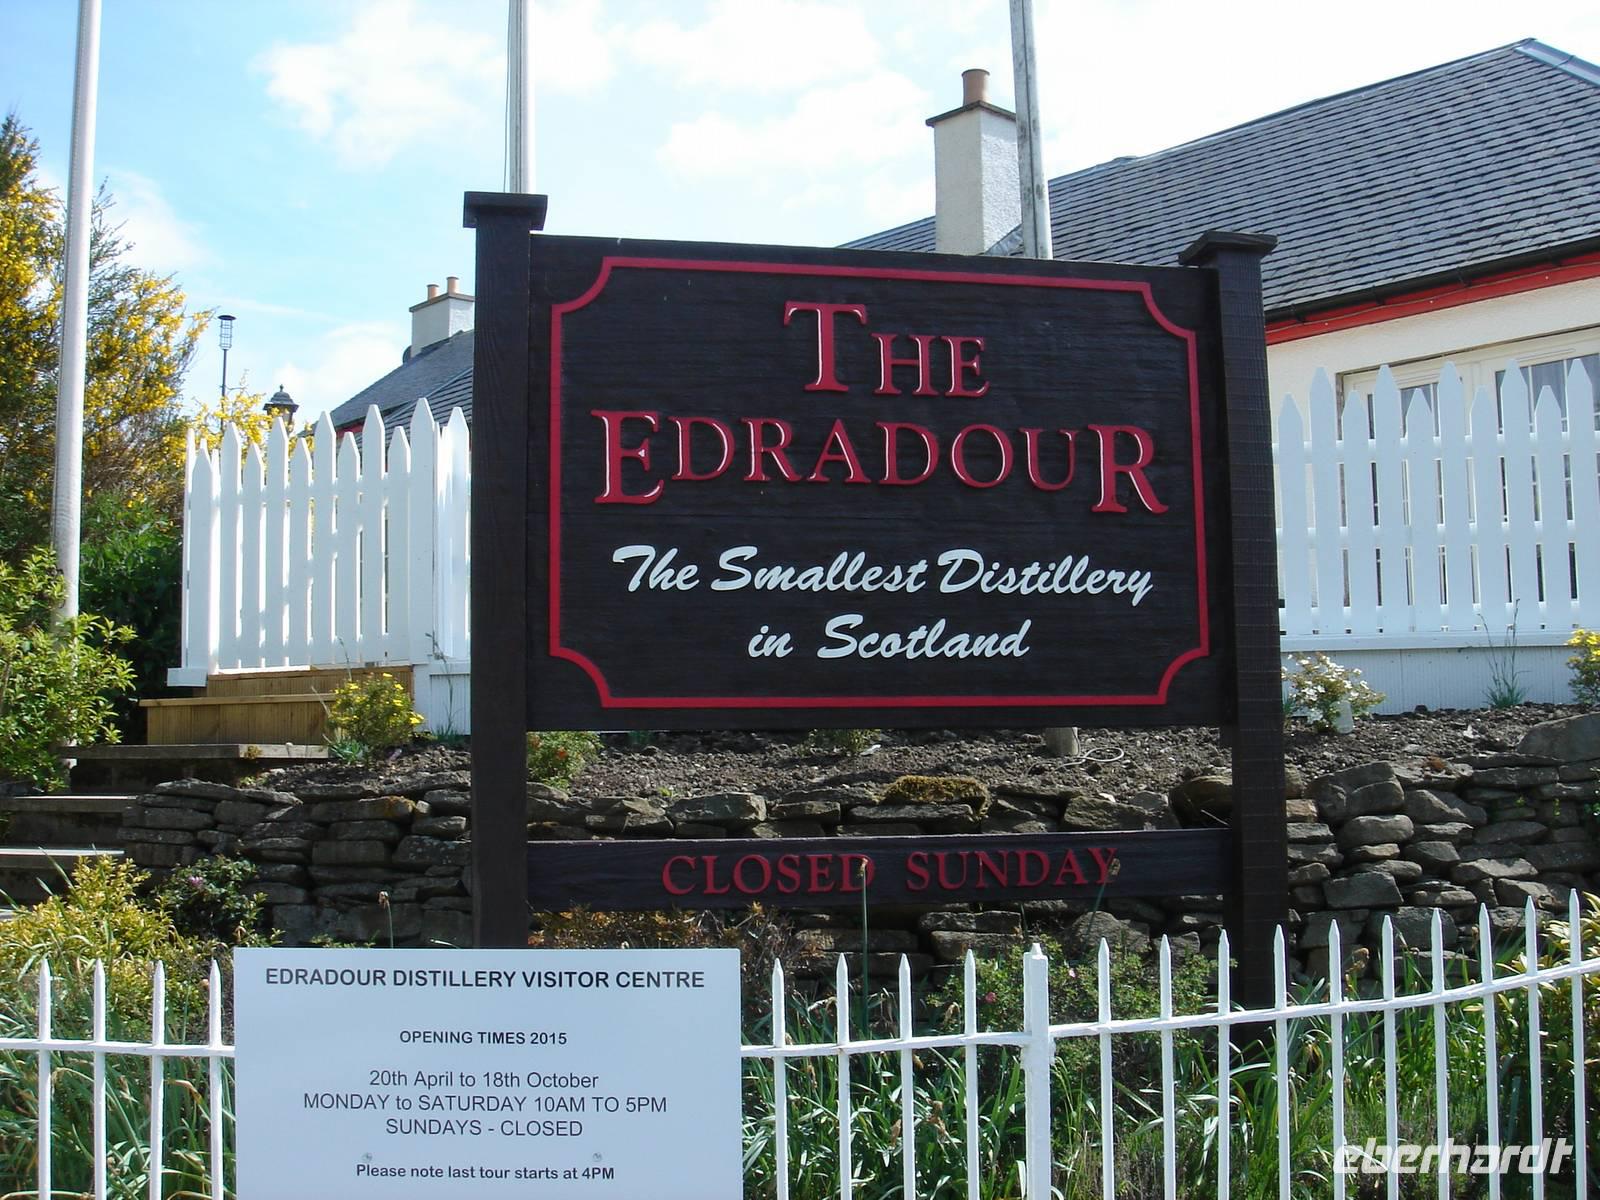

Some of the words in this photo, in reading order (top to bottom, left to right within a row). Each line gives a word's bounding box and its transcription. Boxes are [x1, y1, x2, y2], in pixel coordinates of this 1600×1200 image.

[783, 301, 990, 397] THE
[591, 410, 1169, 514] EDRADOUR
[612, 545, 700, 592] The
[711, 546, 928, 594] Smallest
[936, 548, 1153, 606] Distillery
[748, 623, 794, 658] in
[817, 614, 1032, 659] Scotland
[662, 855, 875, 895] CLOSED
[905, 848, 1119, 890] SUNDAY
[265, 968, 387, 987] EDRADOUR
[393, 969, 516, 988] DISTILLERY
[522, 970, 609, 989] VISITOR
[615, 970, 705, 989] CENTRE
[399, 1030, 473, 1044] OPENING
[477, 1031, 525, 1045] TIMES
[530, 1032, 567, 1045] 2015
[369, 1070, 407, 1087] 20th
[413, 1070, 453, 1091] April
[459, 1072, 476, 1087] to
[482, 1072, 520, 1088] 18th
[526, 1072, 599, 1089] October
[304, 1093, 390, 1110] MONDAY
[396, 1095, 412, 1111] to
[418, 1095, 527, 1112] SATURDAY
[534, 1096, 586, 1113] 10AM
[591, 1096, 620, 1113] TO
[625, 1097, 667, 1113] 5PM
[385, 1118, 482, 1136] SUNDAYS
[500, 1119, 583, 1137] CLOSED
[356, 1164, 406, 1178] Please
[410, 1167, 444, 1178] note
[448, 1165, 475, 1178] last
[479, 1167, 511, 1179] tour
[514, 1167, 559, 1179] starts
[563, 1168, 578, 1180] at
[582, 1167, 614, 1180] 4PM
